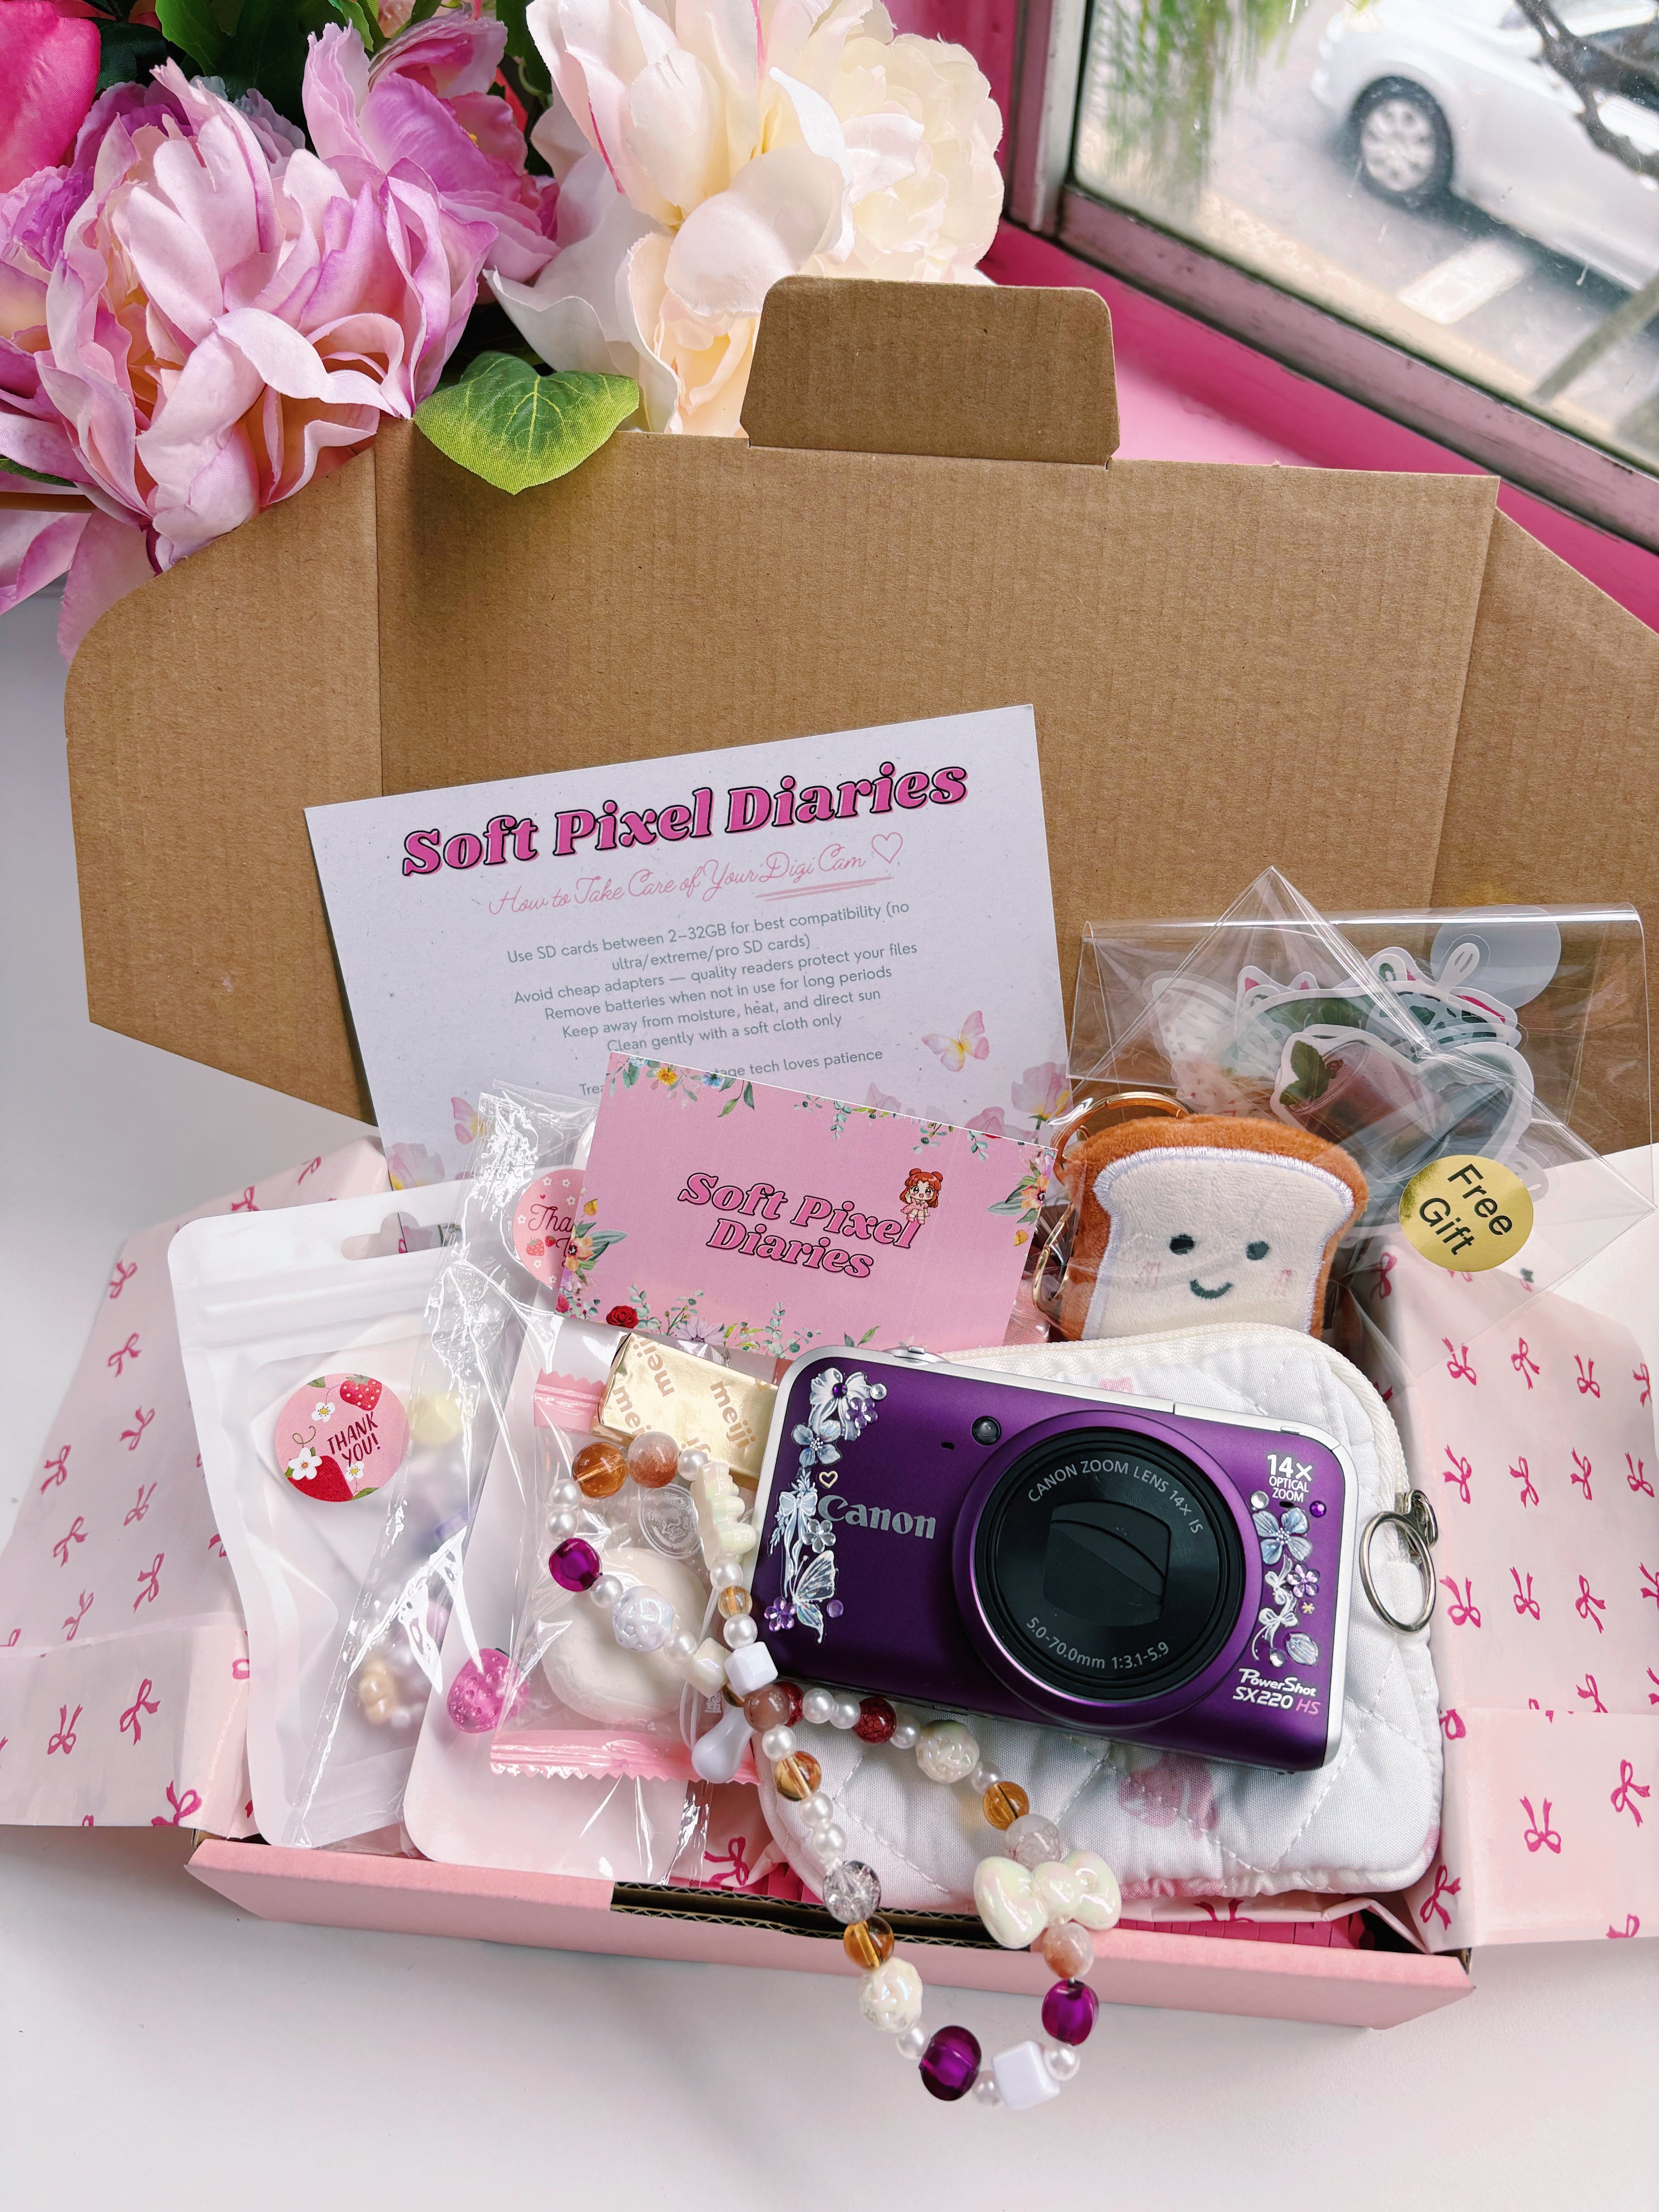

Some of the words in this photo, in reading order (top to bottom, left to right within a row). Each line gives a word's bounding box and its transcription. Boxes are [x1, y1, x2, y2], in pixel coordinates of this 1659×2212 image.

[402, 814, 539, 877] Soft
[553, 787, 714, 857] Pixel
[725, 761, 968, 835] Diaries
[489, 885, 553, 915] How
[552, 887, 572, 908] to
[575, 876, 624, 905] Take
[628, 868, 677, 897] Care
[680, 865, 702, 898] of
[702, 859, 760, 902] Your
[760, 851, 816, 884] Digi
[818, 843, 866, 872] Cam
[507, 950, 533, 963] Use
[537, 945, 556, 959] SD
[561, 940, 599, 956] cards
[602, 935, 664, 951] between
[731, 921, 750, 934] for
[753, 917, 785, 931] best
[789, 905, 881, 927] compatibility
[886, 901, 909, 918] (no
[612, 945, 740, 971] ultra/extreme/pro
[743, 940, 763, 954] SD
[768, 933, 810, 951] cards)
[514, 987, 553, 1004] Avoid
[557, 985, 600, 998] cheap
[604, 976, 664, 992] adapters
[691, 966, 737, 984] quality
[742, 959, 794, 975] readers
[798, 950, 850, 971] protect
[853, 948, 885, 964] your
[889, 942, 918, 956] files
[544, 1005, 601, 1020] Remove
[605, 996, 665, 1012] batteries
[669, 991, 706, 1004] when
[710, 986, 733, 999] not
[736, 985, 749, 996] in
[753, 983, 775, 994] use
[780, 978, 799, 991] for
[803, 975, 835, 988] long
[839, 965, 892, 987] periods
[562, 1025, 598, 1039] Keep
[603, 1021, 637, 1033] away
[642, 1015, 674, 1028] from
[677, 1009, 740, 1023] moisture,
[744, 1000, 779, 1016] heat,
[784, 995, 809, 1011] and
[813, 992, 855, 1007] direct
[858, 991, 881, 1001] sun
[607, 1039, 647, 1052] Clean
[651, 1031, 694, 1050] gently
[699, 1026, 728, 1041] with
[732, 1028, 740, 1037] a
[744, 1021, 769, 1036] soft
[773, 1016, 808, 1032] cloth
[813, 1013, 842, 1028] only
[749, 1060, 780, 1074] tech
[783, 1058, 820, 1071] loves
[823, 1051, 883, 1069] patience
[528, 1204, 574, 1232] Tha
[678, 1173, 788, 1219] Soft
[790, 1196, 922, 1249] Pixel
[1447, 1164, 1513, 1235] Free
[707, 1218, 874, 1278] Diaries
[1419, 1198, 1475, 1255] Gift
[327, 1411, 378, 1454] THANK
[710, 1381, 756, 1448] meiji
[342, 1433, 381, 1468] YOU!
[1028, 1464, 1077, 1502] CANON
[1081, 1459, 1128, 1475] ZOOM
[1134, 1466, 1169, 1492] LENS
[1189, 1519, 1203, 1533] IS
[1269, 1476, 1309, 1493] OPTICAL
[1272, 1487, 1304, 1503] ZOOM
[818, 1495, 936, 1539] Canon
[1027, 1617, 1105, 1669] 5.0-70.0mm
[1112, 1642, 1169, 1669] 1:3.1-5.9
[1233, 1686, 1294, 1709] SX220
[1296, 1698, 1321, 1715] HS
[1239, 1668, 1316, 1697] PowerShot
